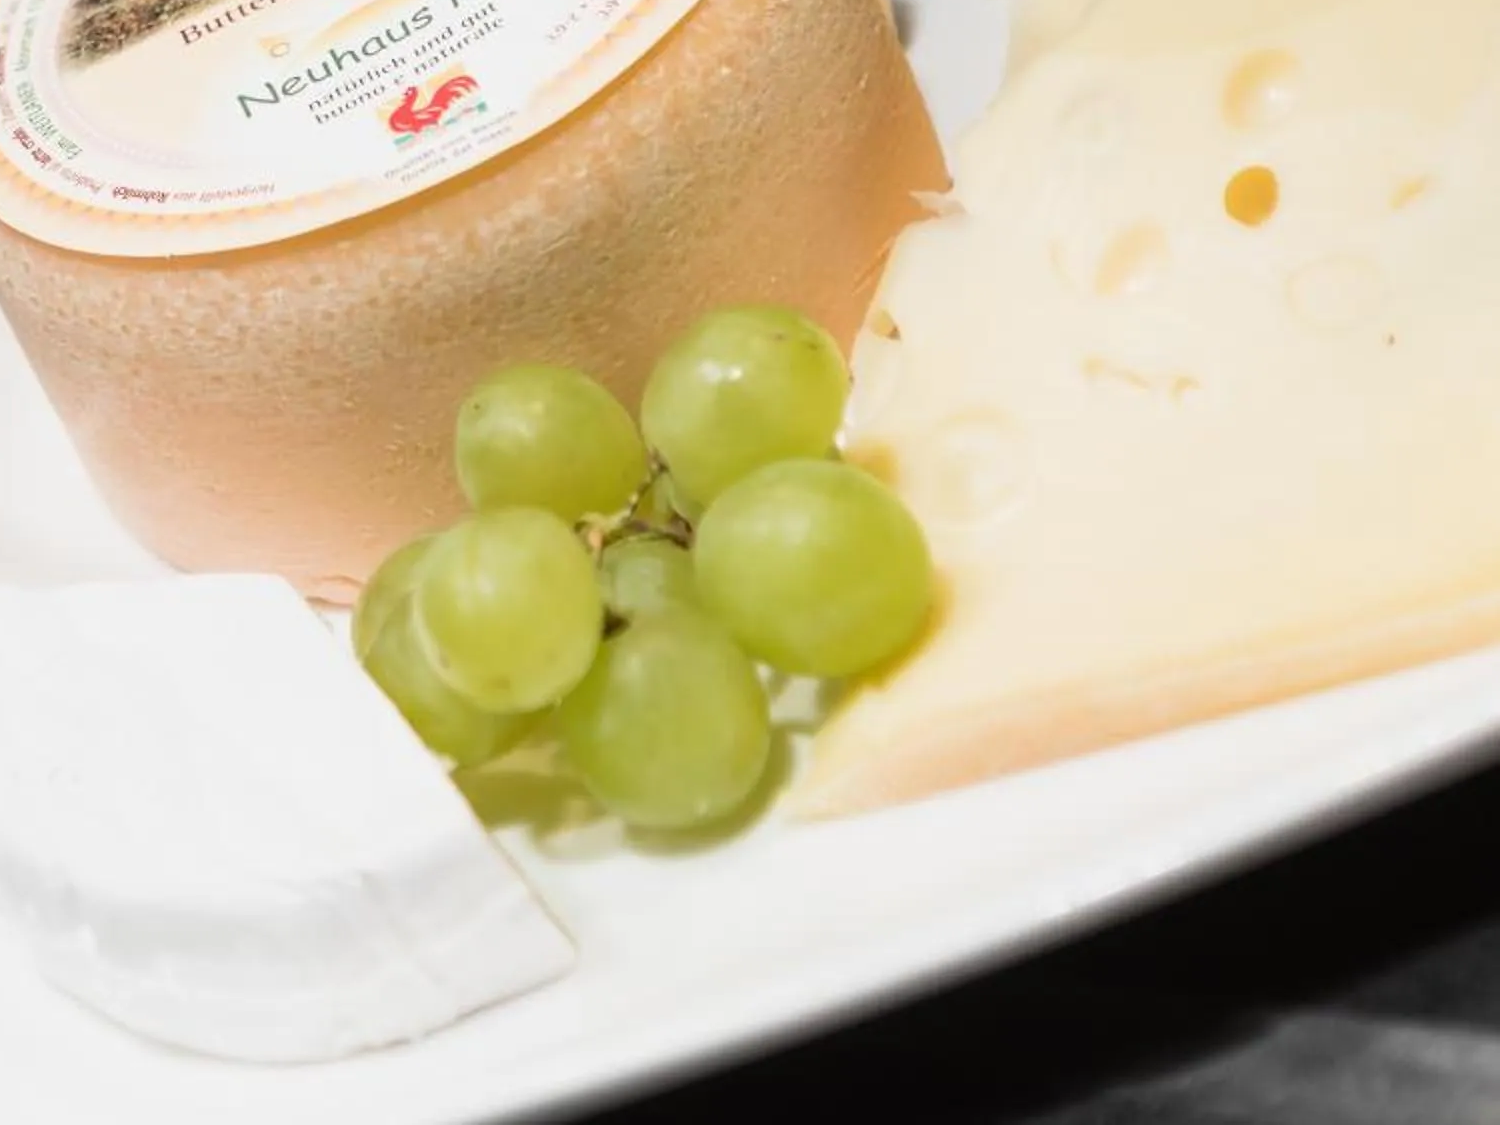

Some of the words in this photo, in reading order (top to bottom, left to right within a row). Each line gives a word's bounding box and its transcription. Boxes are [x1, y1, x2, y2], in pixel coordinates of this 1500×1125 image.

[236, 5, 435, 118] Neuhaus
[308, 56, 407, 111] natürlich
[413, 26, 453, 58] und
[460, 2, 498, 32] gut
[315, 84, 386, 125] buono
[414, 17, 505, 75] naturale
